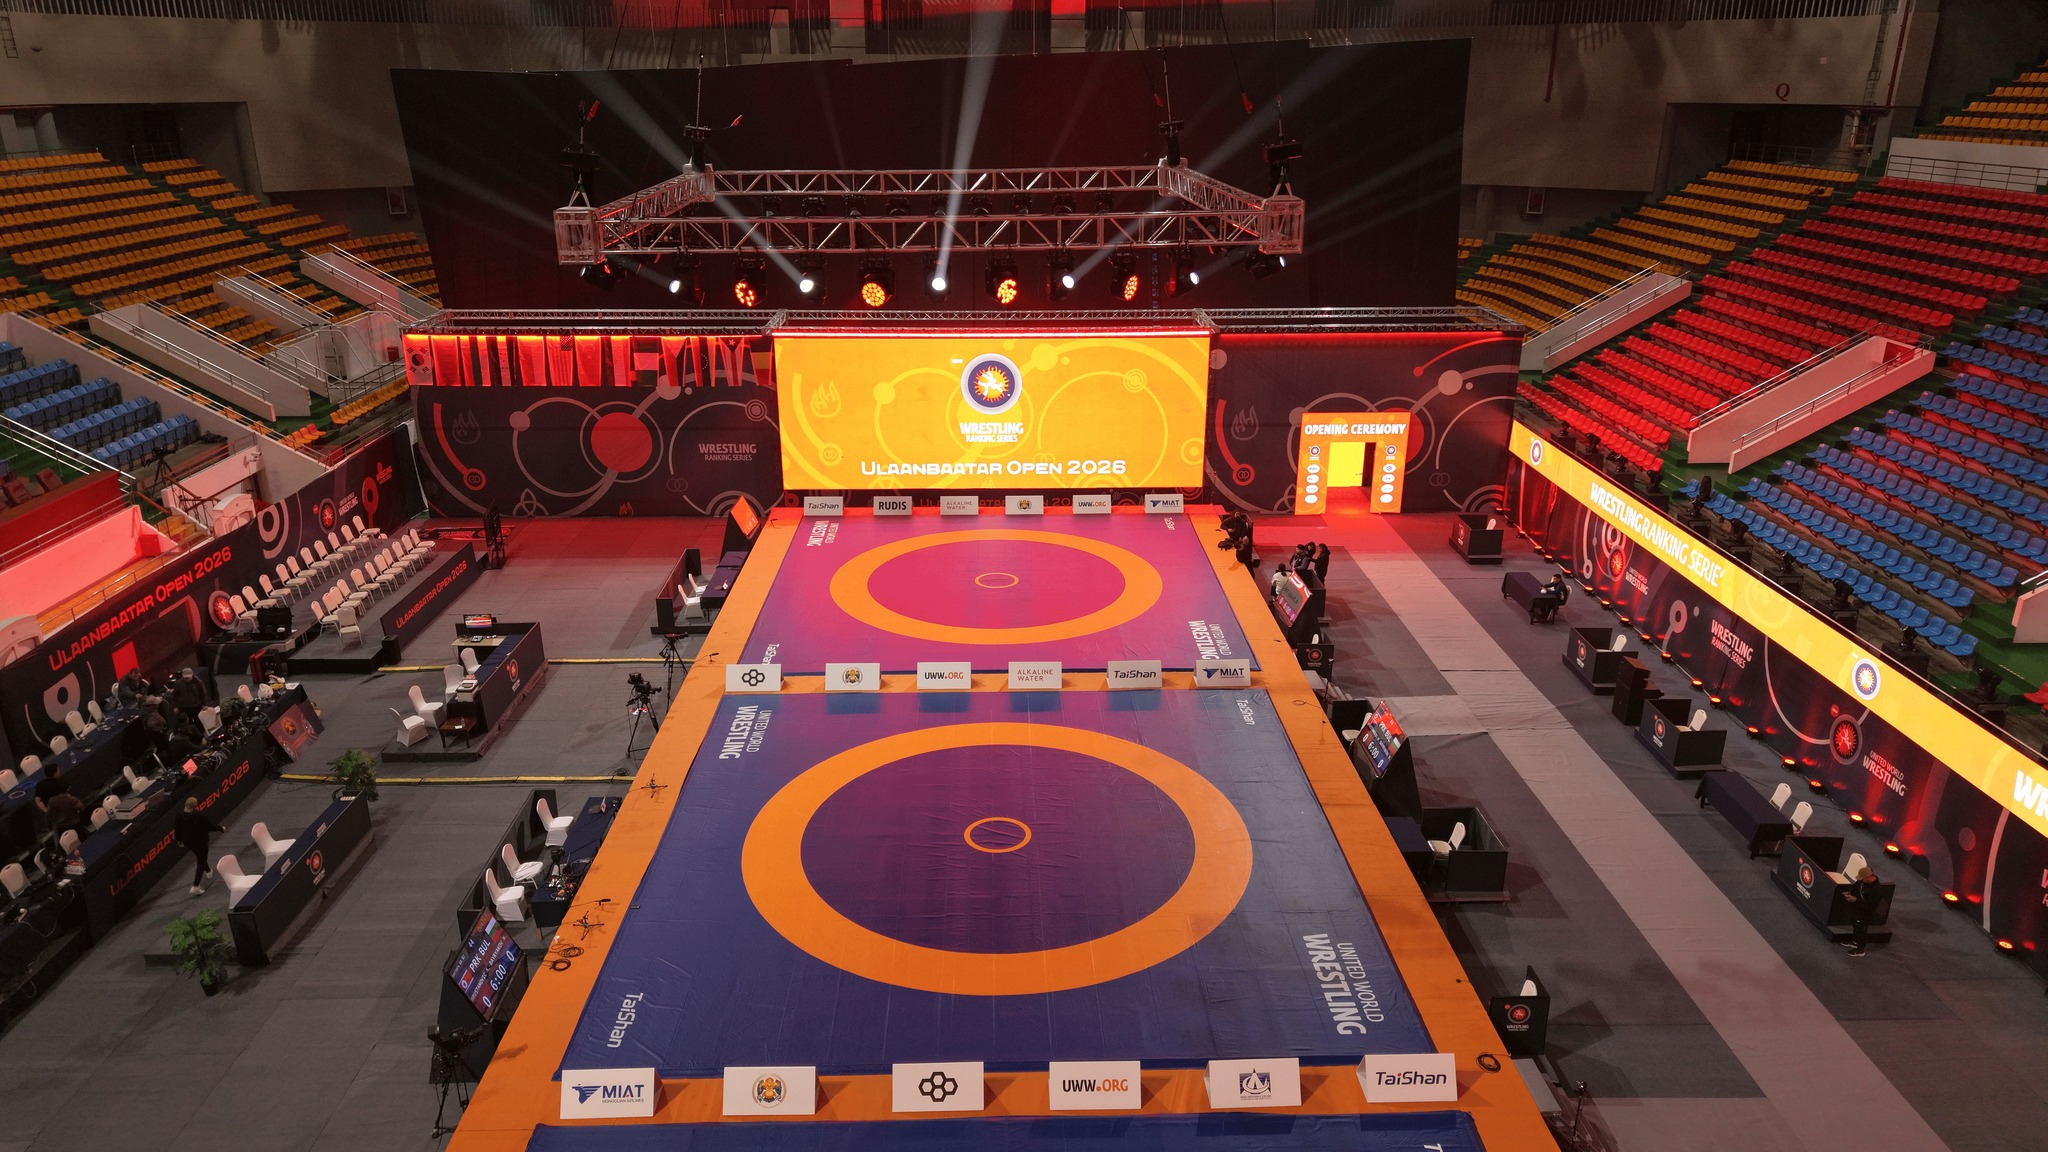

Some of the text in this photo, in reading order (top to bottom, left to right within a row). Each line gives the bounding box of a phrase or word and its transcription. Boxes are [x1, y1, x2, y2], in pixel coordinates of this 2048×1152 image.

[960, 422, 1024, 434] WRESTLING
[965, 434, 1018, 443] RANKING SERIES
[1304, 423, 1407, 435] OPENING CEREMONY
[698, 443, 757, 454] WRESTLING
[861, 460, 1003, 475] ULAANBAATAR
[1067, 459, 1127, 475] 2026
[807, 502, 840, 510] TaiShan
[878, 501, 907, 510] RUDIS
[1590, 481, 1644, 534] WRESTLING
[1641, 517, 1690, 564] RANKING
[435, 575, 452, 593] OPEN
[451, 559, 468, 580] 2026
[48, 545, 232, 672] ULAANBAATAR OPEN 2026
[1188, 620, 1220, 660] WRESTLING
[1711, 619, 1754, 663] WRESTLING
[1711, 636, 1747, 669] RANKING SERIES
[924, 671, 964, 680] UWW.ORG
[1114, 669, 1157, 679] TaiShan
[1220, 668, 1244, 676] MIAT
[1235, 699, 1256, 725] TaiShan
[719, 705, 759, 760] WRESTLING
[745, 709, 773, 753] UNITED WORLD
[1367, 741, 1380, 759] 6:00
[1377, 759, 1384, 769] 0
[1869, 750, 1905, 781] UNITED WORLD
[195, 789, 222, 812] PEN
[221, 759, 250, 794] 2026
[1863, 755, 1906, 797] WRESTLING
[469, 954, 482, 973] PRK
[478, 939, 491, 956] BUL
[505, 950, 515, 962] 0
[489, 964, 507, 991] 6:00
[1302, 933, 1367, 1035] WRESTLING
[1337, 942, 1384, 1023] UNITED WORLD
[482, 995, 491, 1008] 0
[606, 992, 644, 1048] TaiShan
[1062, 1079, 1129, 1092] UWW.ORG
[1375, 1071, 1447, 1086] TaiShan
[602, 1084, 645, 1098] MIAT
